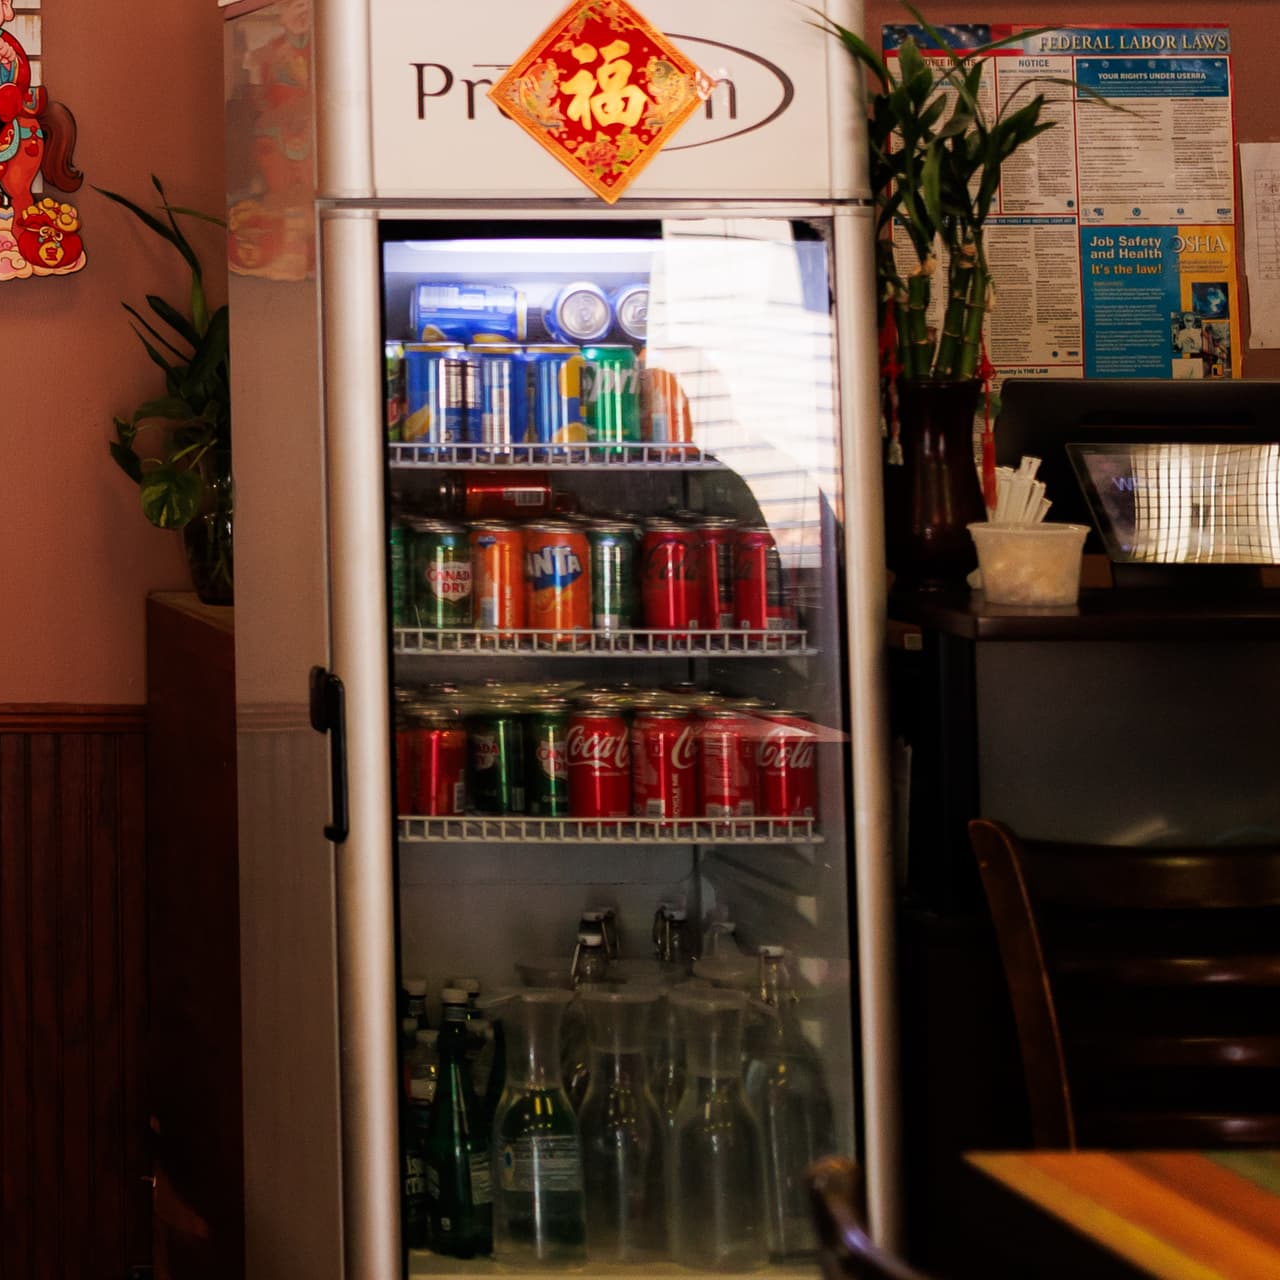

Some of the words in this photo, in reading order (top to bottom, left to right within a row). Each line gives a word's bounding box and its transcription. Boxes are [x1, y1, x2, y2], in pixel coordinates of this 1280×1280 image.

[1040, 35, 1115, 52] FEDERAL
[1120, 34, 1177, 50] LABOR
[1182, 34, 1228, 51] LAWS
[1018, 59, 1050, 68] NOTICE
[559, 39, 648, 130] 福
[1090, 236, 1114, 247] Job
[1119, 235, 1162, 249] Safety
[1170, 234, 1226, 253] OSHA
[1090, 248, 1115, 259] and
[1119, 248, 1163, 259] Health
[1091, 264, 1110, 275] It's
[1114, 264, 1133, 275] the
[1136, 263, 1162, 275] law!
[527, 546, 582, 577] NTA
[428, 569, 471, 582] CANAD
